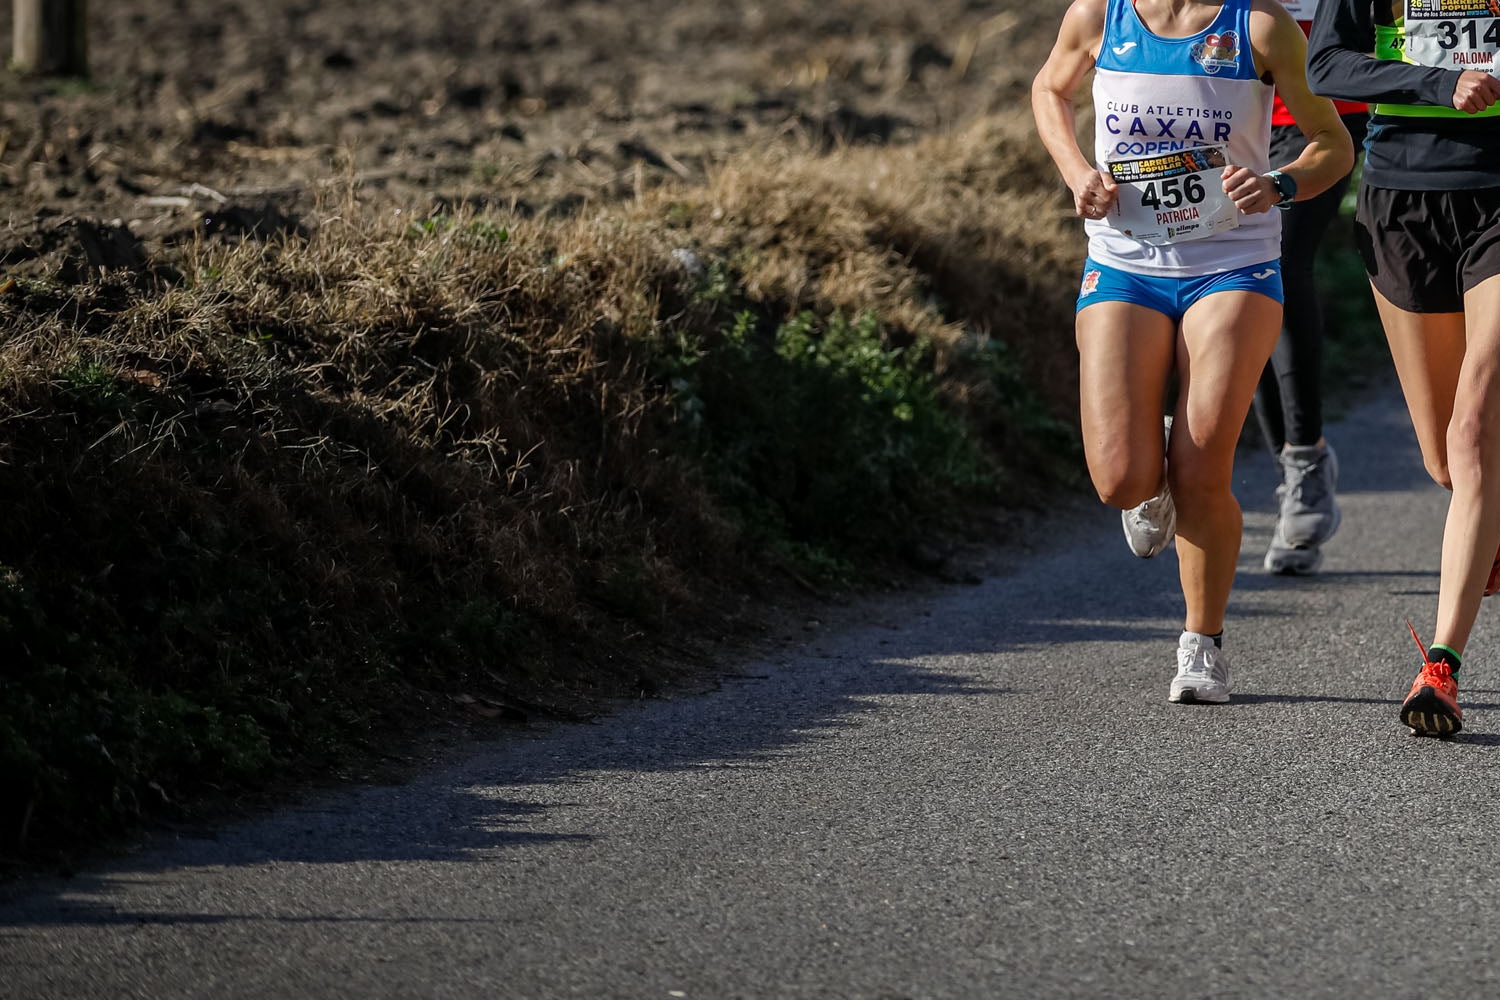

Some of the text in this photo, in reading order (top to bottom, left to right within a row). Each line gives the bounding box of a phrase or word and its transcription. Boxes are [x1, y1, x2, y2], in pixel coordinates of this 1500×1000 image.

[1441, 3, 1486, 11] POPULAR
[1453, 51, 1493, 64] PALOMA
[1107, 101, 1233, 120] CLUB ATLETISMO
[1105, 113, 1231, 142] CAXAR
[1111, 163, 1123, 172] 26
[1139, 155, 1181, 168] CARRERA
[1139, 162, 1182, 173] POPULAR
[1141, 174, 1206, 211] 456
[1156, 206, 1200, 225] PATRICIA
